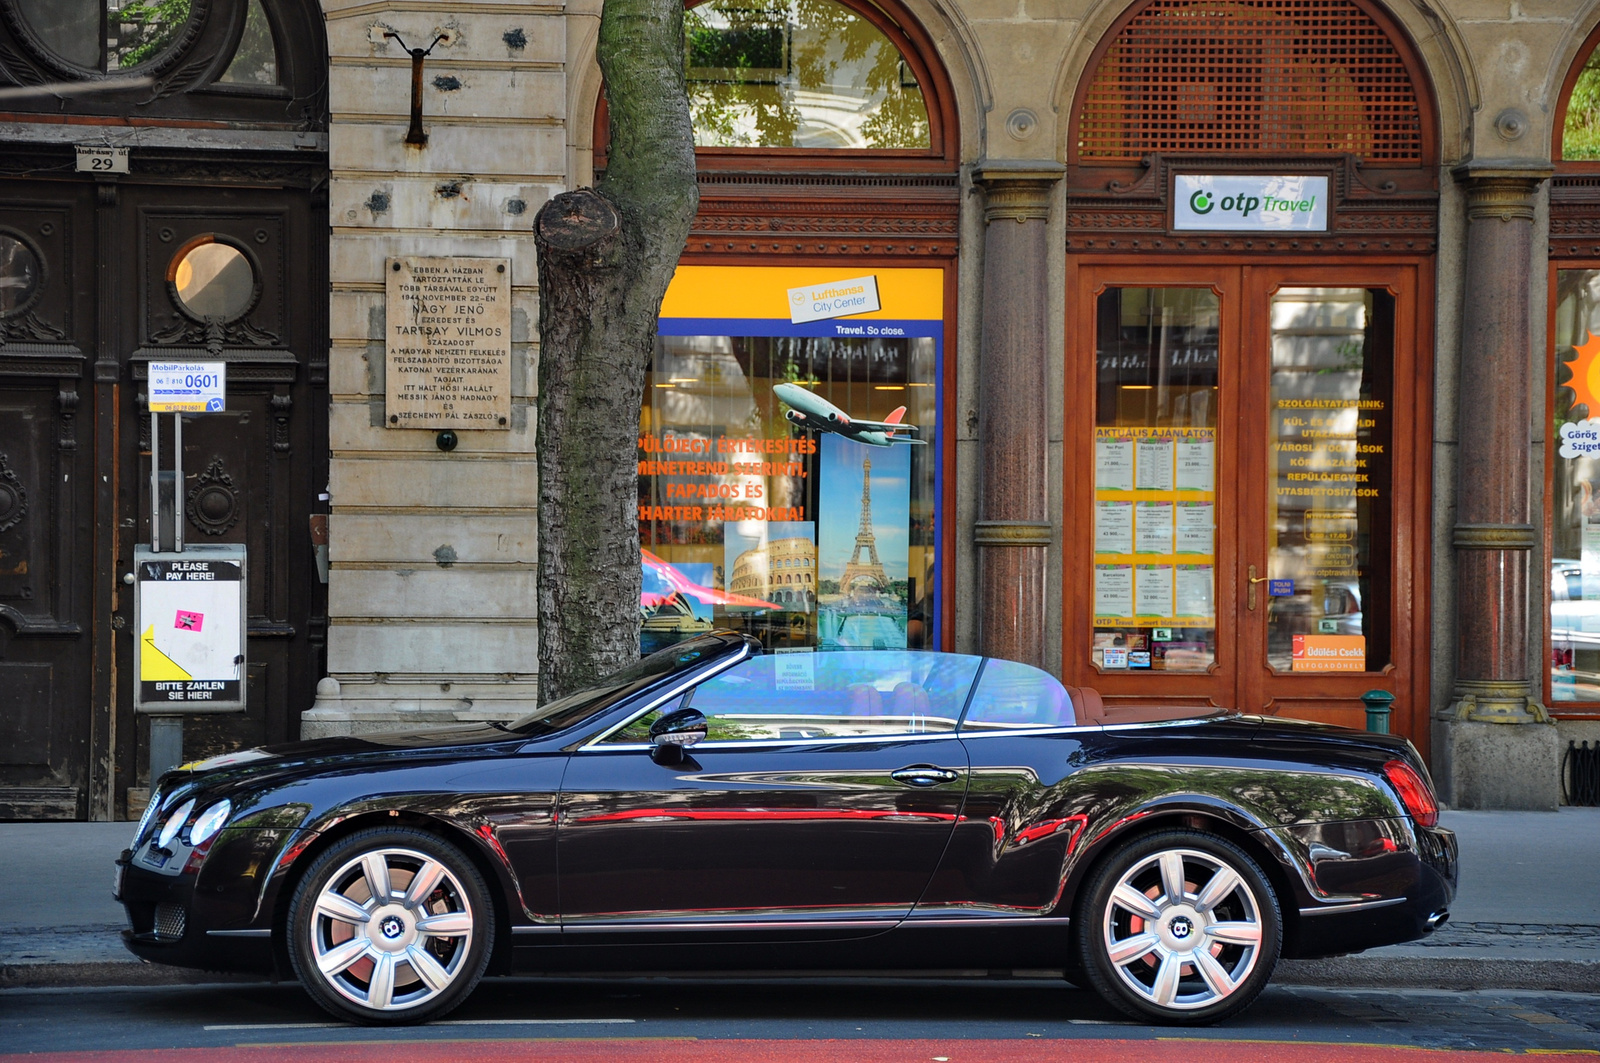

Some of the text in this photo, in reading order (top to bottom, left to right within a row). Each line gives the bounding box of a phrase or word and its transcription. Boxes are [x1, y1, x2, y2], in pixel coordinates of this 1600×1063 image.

[78, 148, 113, 157] Andrássy
[92, 158, 113, 170] 29
[1220, 192, 1316, 217] otp Travel
[412, 274, 472, 282] TARTÓZTATTÁK
[424, 284, 463, 292] TÁRSÁVAL
[466, 284, 498, 292] EGYÜTT
[812, 285, 864, 301] Lufthansa
[412, 304, 446, 314] NAGY
[813, 296, 866, 313] City Center
[466, 316, 476, 324] ÉS
[396, 326, 502, 336] TARTSAY VILMOS
[836, 325, 905, 336] Travel. So close.
[427, 338, 474, 346] SZÁZADOST
[436, 366, 498, 374] VEZÉRKARÁNAK
[185, 374, 218, 388] 0601
[463, 384, 493, 392] HALÁLT
[432, 392, 456, 400] JÁNOS
[446, 412, 460, 420] PÁL
[1096, 428, 1214, 438] AKTUÁLIS AJÁNLATOK
[1568, 430, 1598, 440] Görög
[717, 435, 816, 454] ÉRTÉKESÍTÉS
[638, 461, 808, 478] MENETREND SZERINTI,
[1287, 472, 1368, 482] REPÜLŐJEGYEK
[666, 481, 763, 498] FAPADOS ÉS
[1277, 486, 1379, 496] UTASBIZTOSÍTÁSOK
[707, 503, 804, 521] JÁRATOKRA!
[172, 562, 208, 570] PLEASE
[166, 572, 214, 580] PAY HERE!
[1308, 646, 1364, 656] Üdülési Csekk
[156, 682, 225, 690] BITTE ZAHLEN
[168, 692, 212, 700] SIE HIER!
